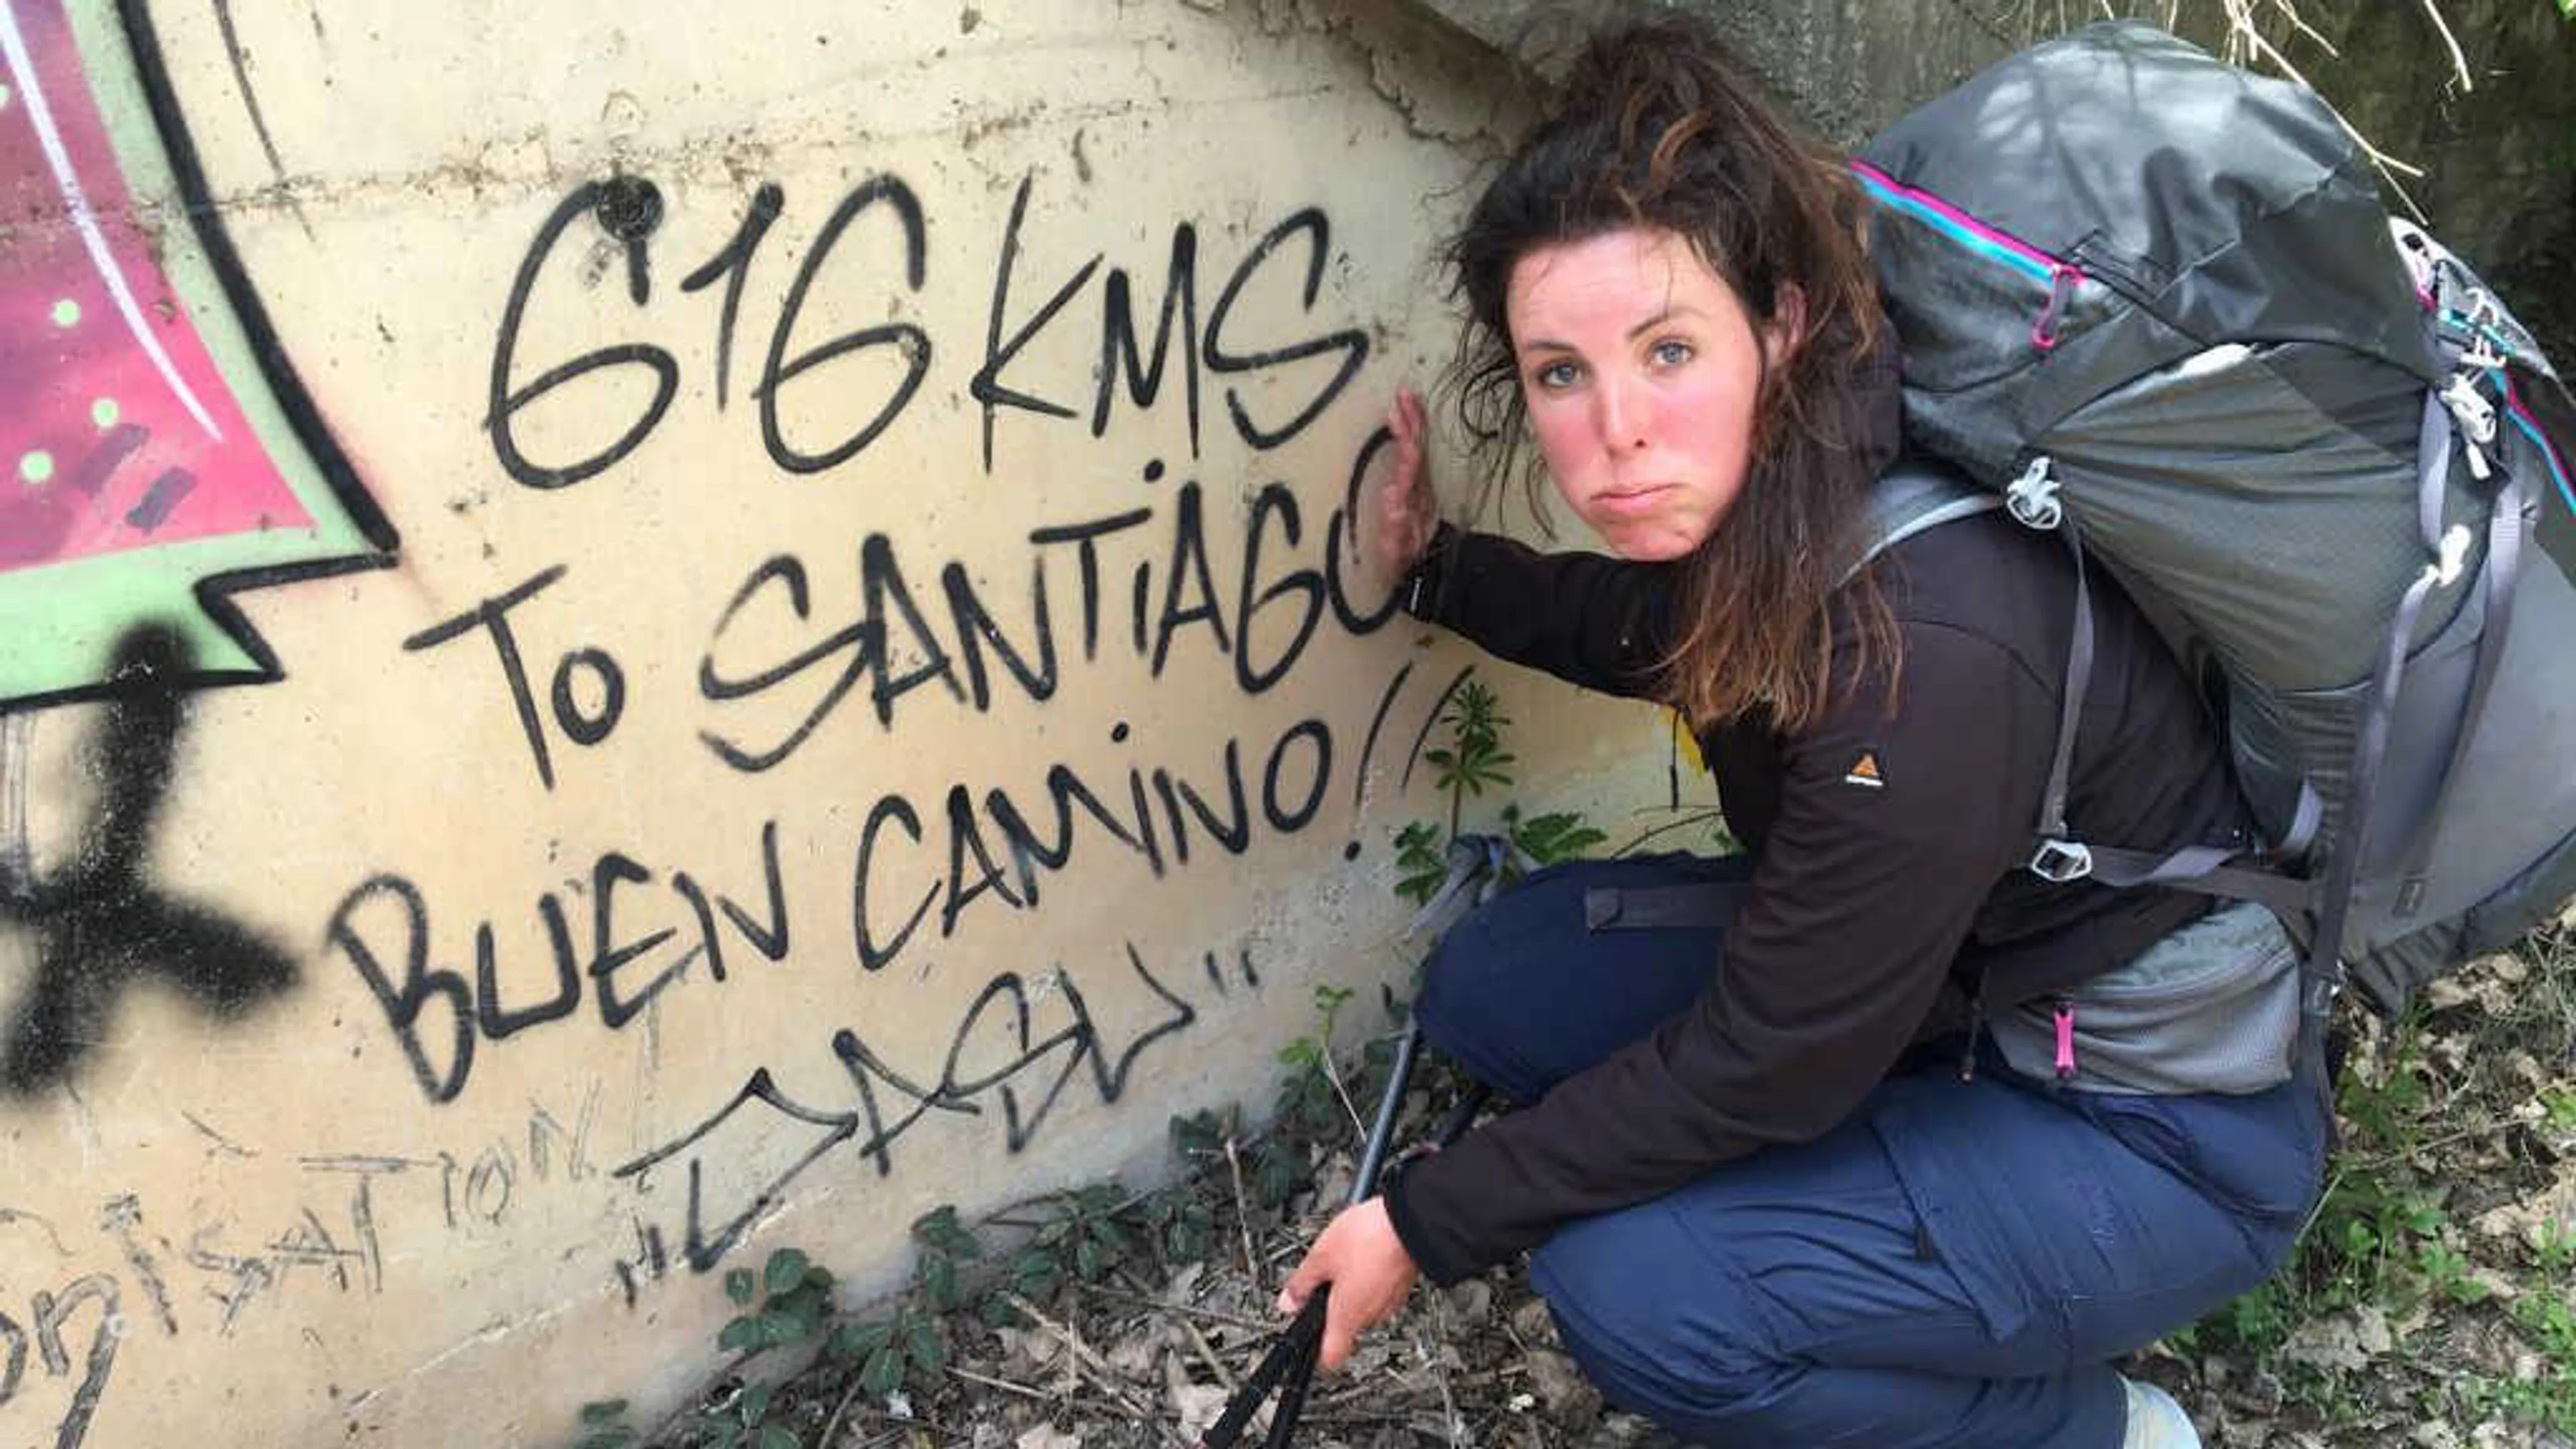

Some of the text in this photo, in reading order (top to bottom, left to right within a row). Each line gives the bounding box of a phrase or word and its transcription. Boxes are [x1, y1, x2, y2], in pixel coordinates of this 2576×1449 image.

[484, 171, 1370, 491] 616 KMS
[329, 820, 792, 1106] BUEN
